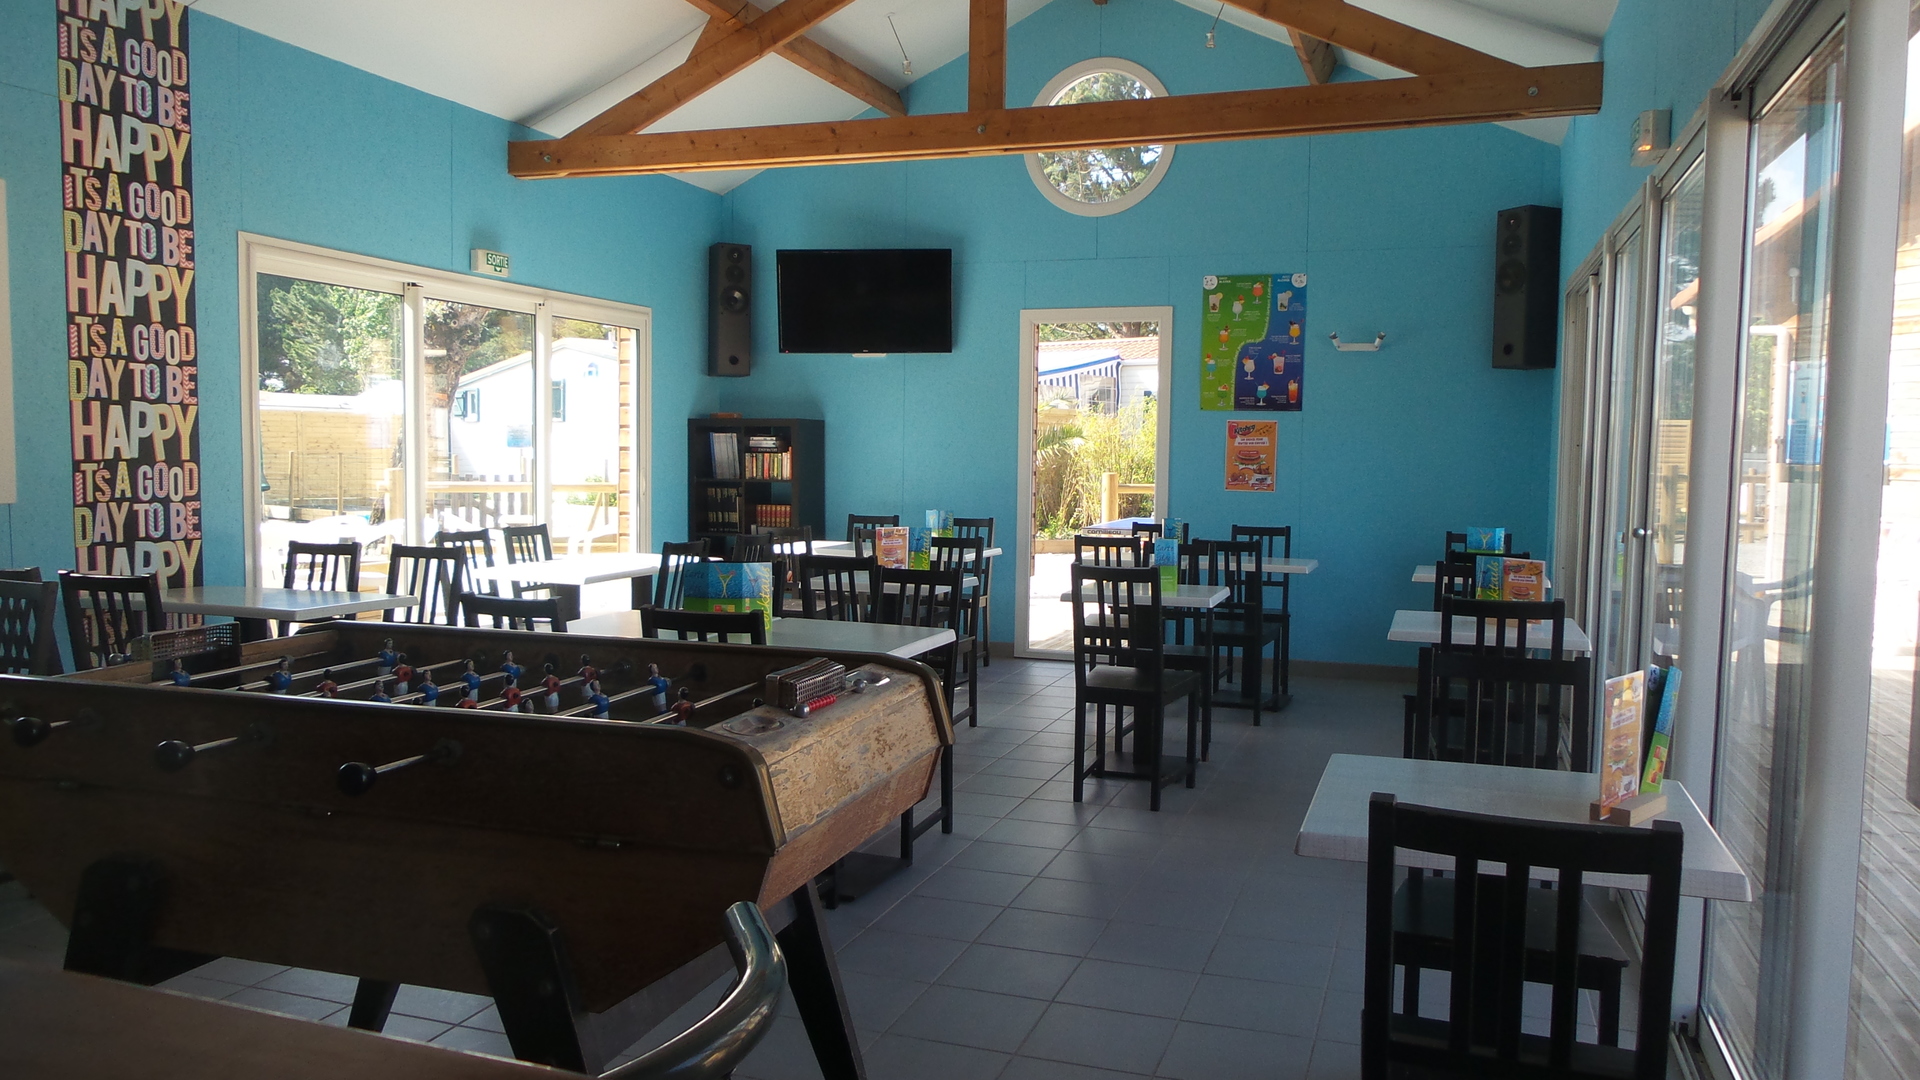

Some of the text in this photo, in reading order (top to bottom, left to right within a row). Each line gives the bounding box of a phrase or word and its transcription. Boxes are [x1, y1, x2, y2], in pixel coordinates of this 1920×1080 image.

[59, 16, 187, 87] IT'S A GOOD
[58, 59, 190, 132] DAY TO BE
[61, 101, 191, 186] HAPPY
[64, 167, 191, 227] IT'S A GOOD
[64, 210, 194, 269] DAY TO BE
[487, 254, 508, 268] SORTIE
[66, 252, 194, 323] HAPPY
[69, 316, 195, 365] IT'S A GOOD
[69, 358, 198, 404] DAY TO BE
[71, 400, 198, 461] HAPPY
[75, 461, 198, 505] IT'S A GOOD
[74, 501, 201, 548] DAY TO BE
[919, 530, 930, 569] ocktails
[1487, 561, 1499, 598] ktails
